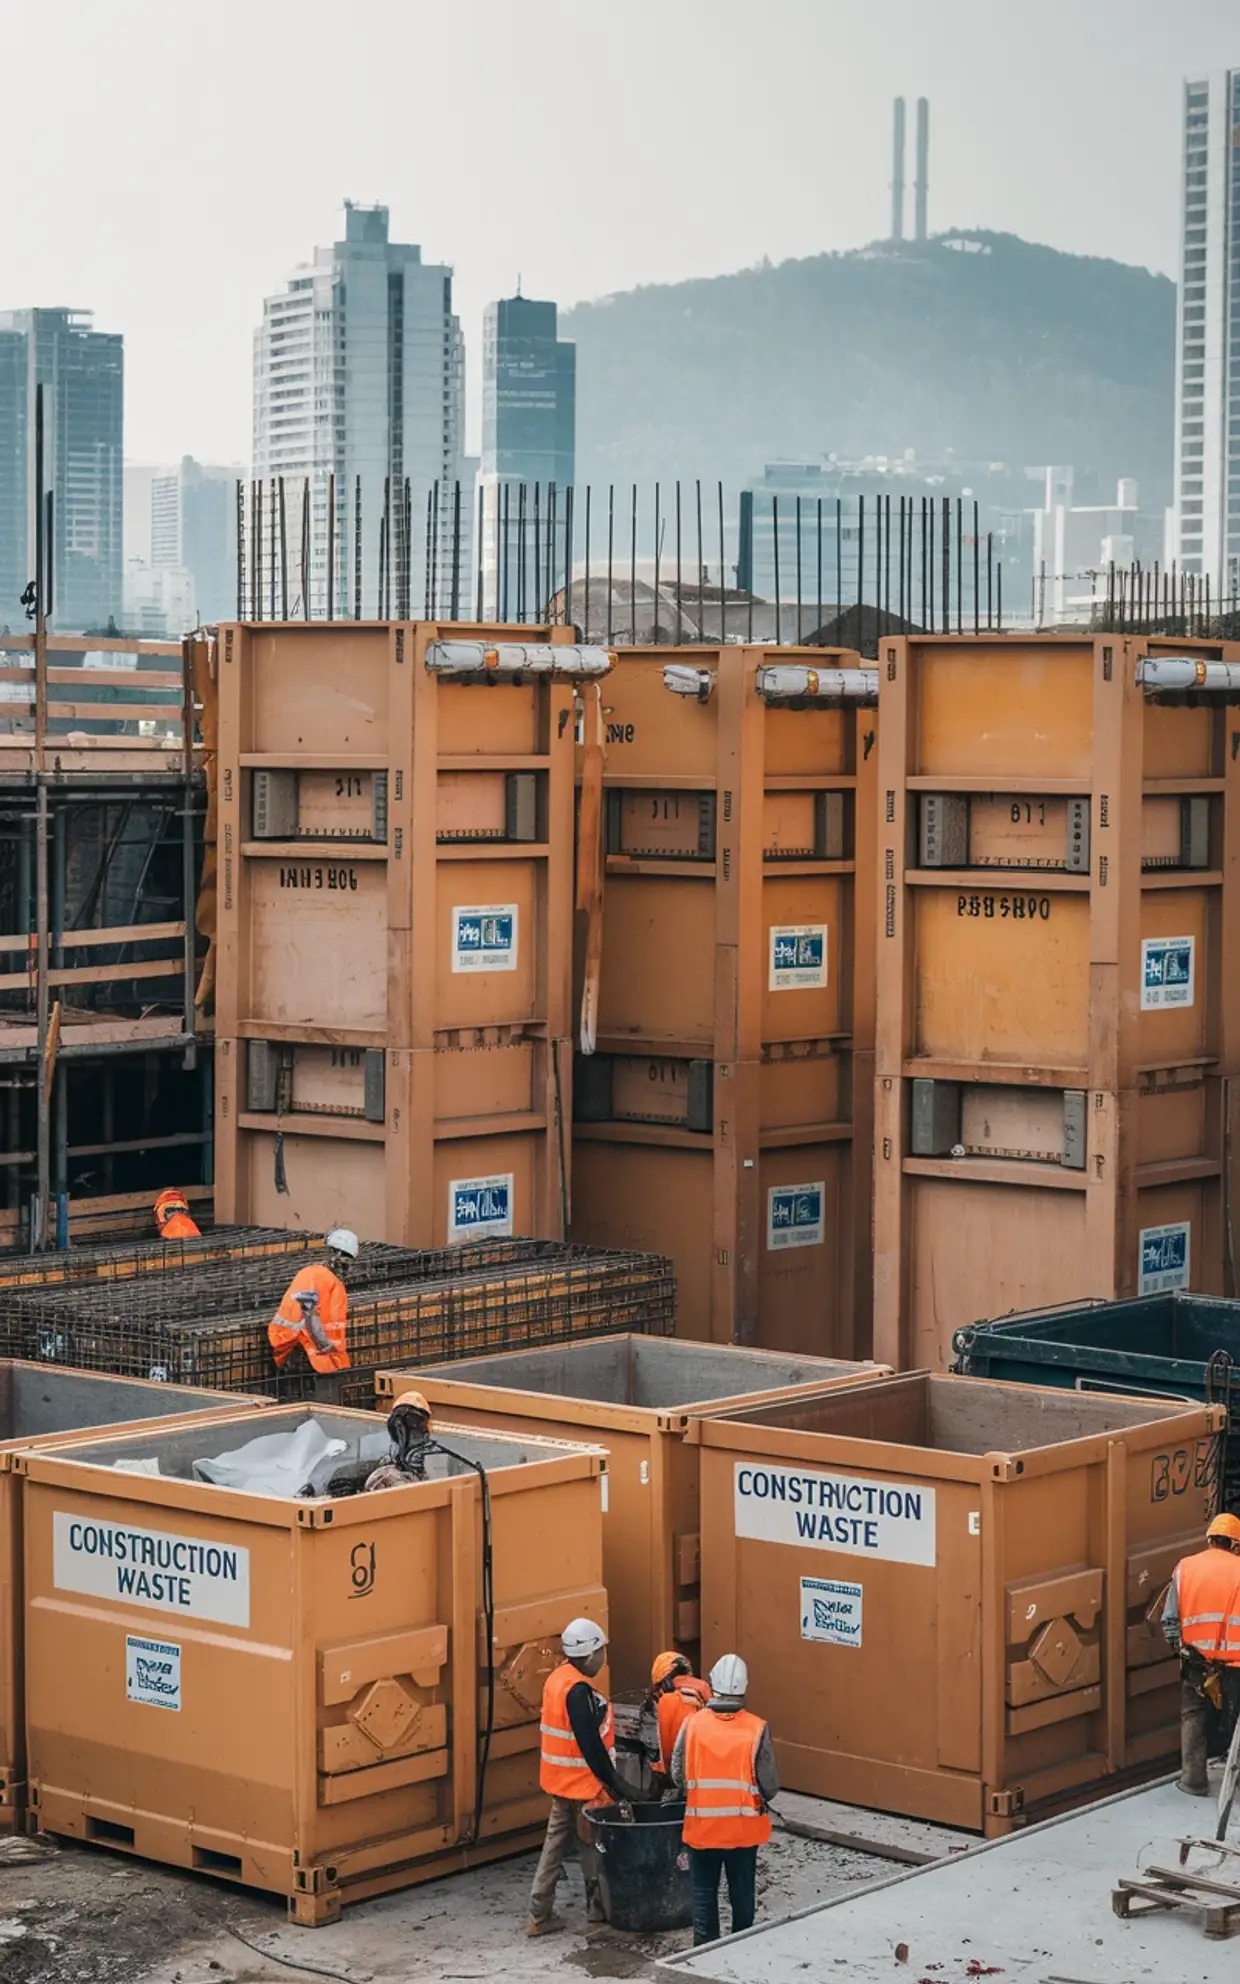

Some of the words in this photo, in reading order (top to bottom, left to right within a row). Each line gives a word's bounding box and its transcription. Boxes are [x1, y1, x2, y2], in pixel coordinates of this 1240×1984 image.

[795, 1511, 879, 1549] WASTE
[69, 1523, 238, 1581] CONSTRUCTION
[117, 1566, 192, 1606] WASTE
